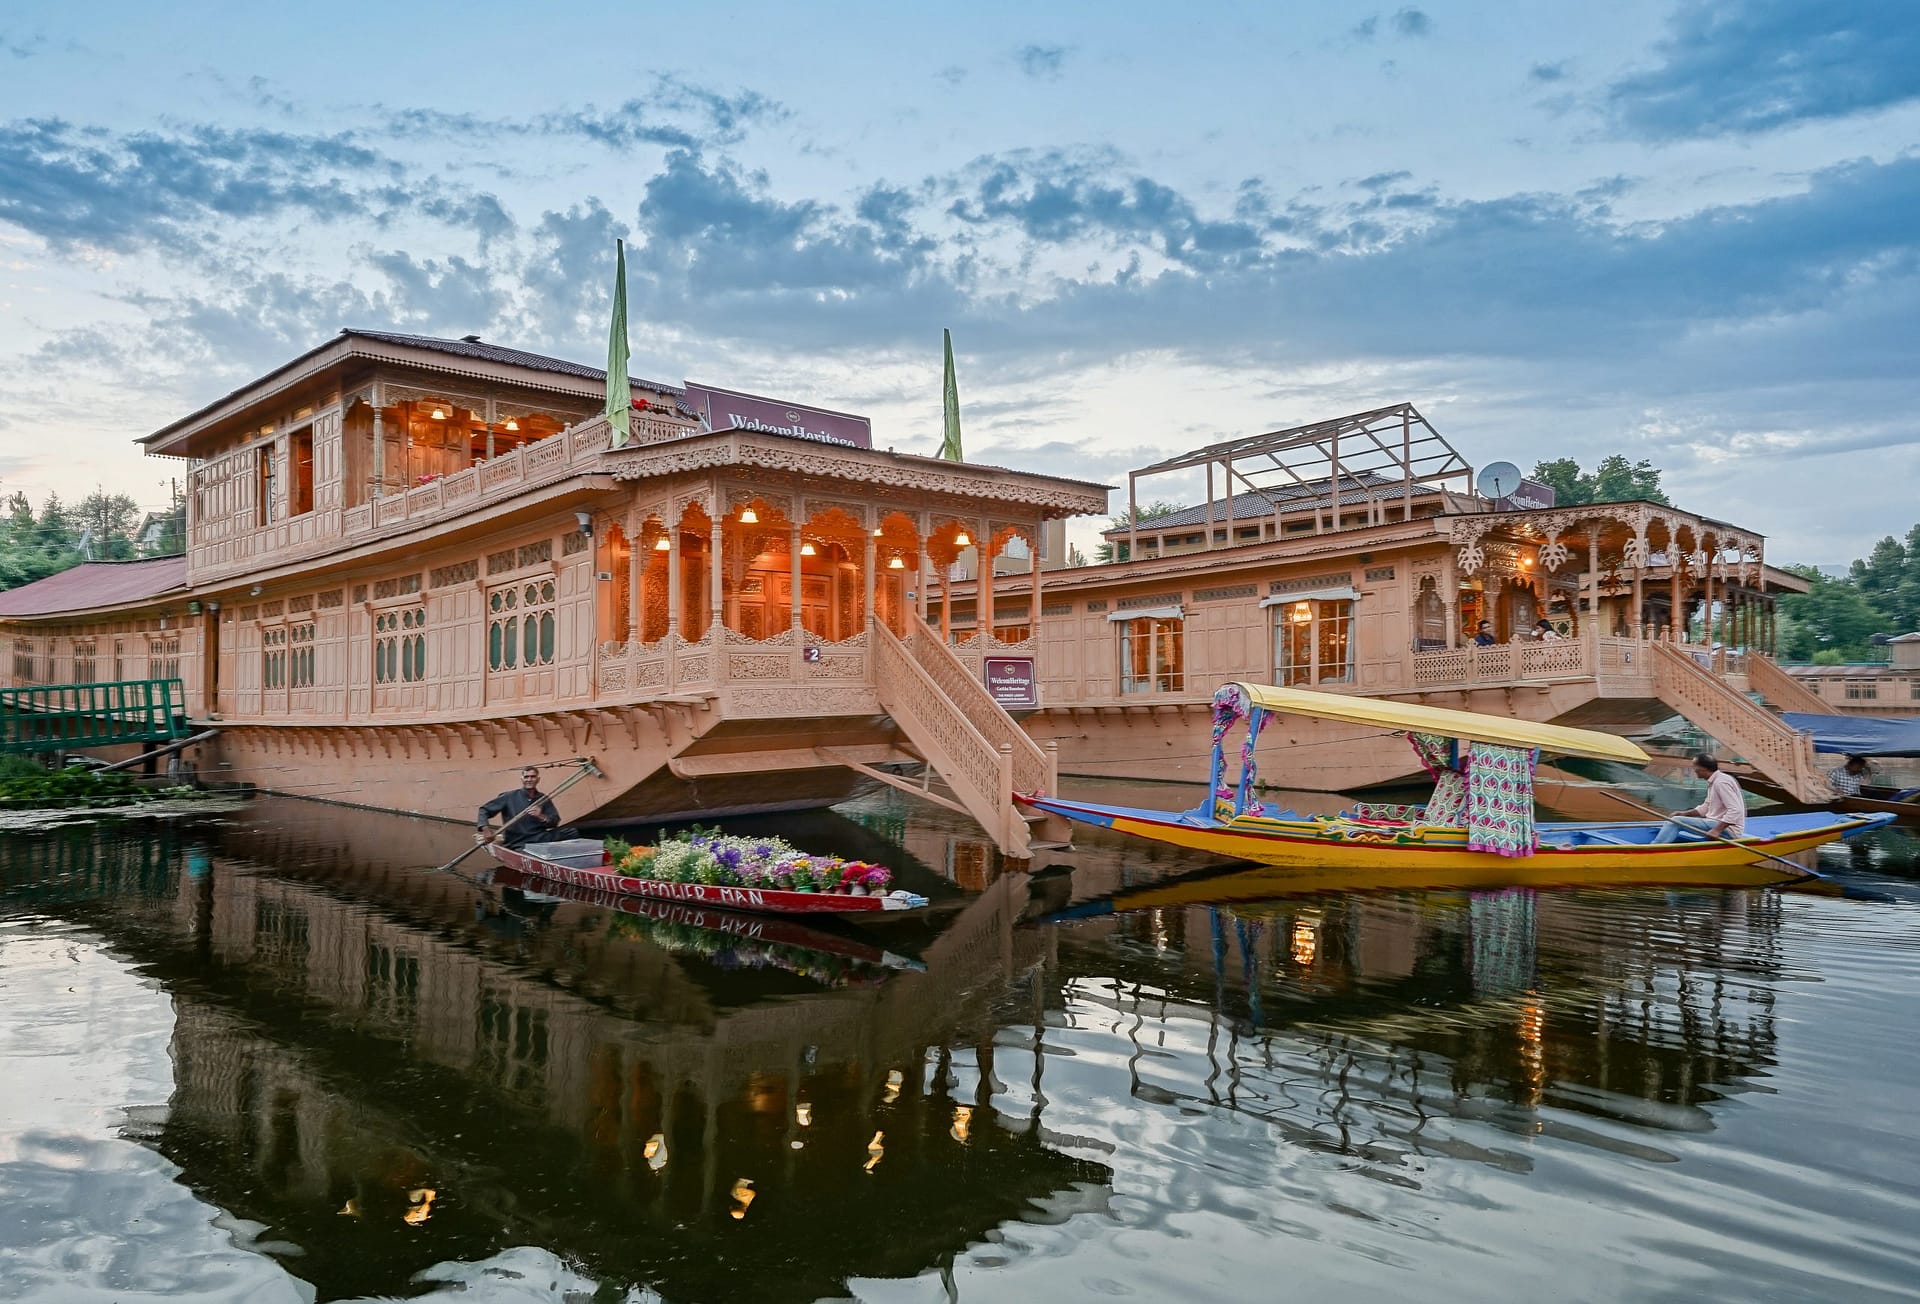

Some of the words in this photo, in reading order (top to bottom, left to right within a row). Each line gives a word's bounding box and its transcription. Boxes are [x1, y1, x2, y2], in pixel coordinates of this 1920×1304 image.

[811, 649, 819, 660] 2
[639, 880, 706, 901] FLOWER
[720, 887, 763, 905] MAN
